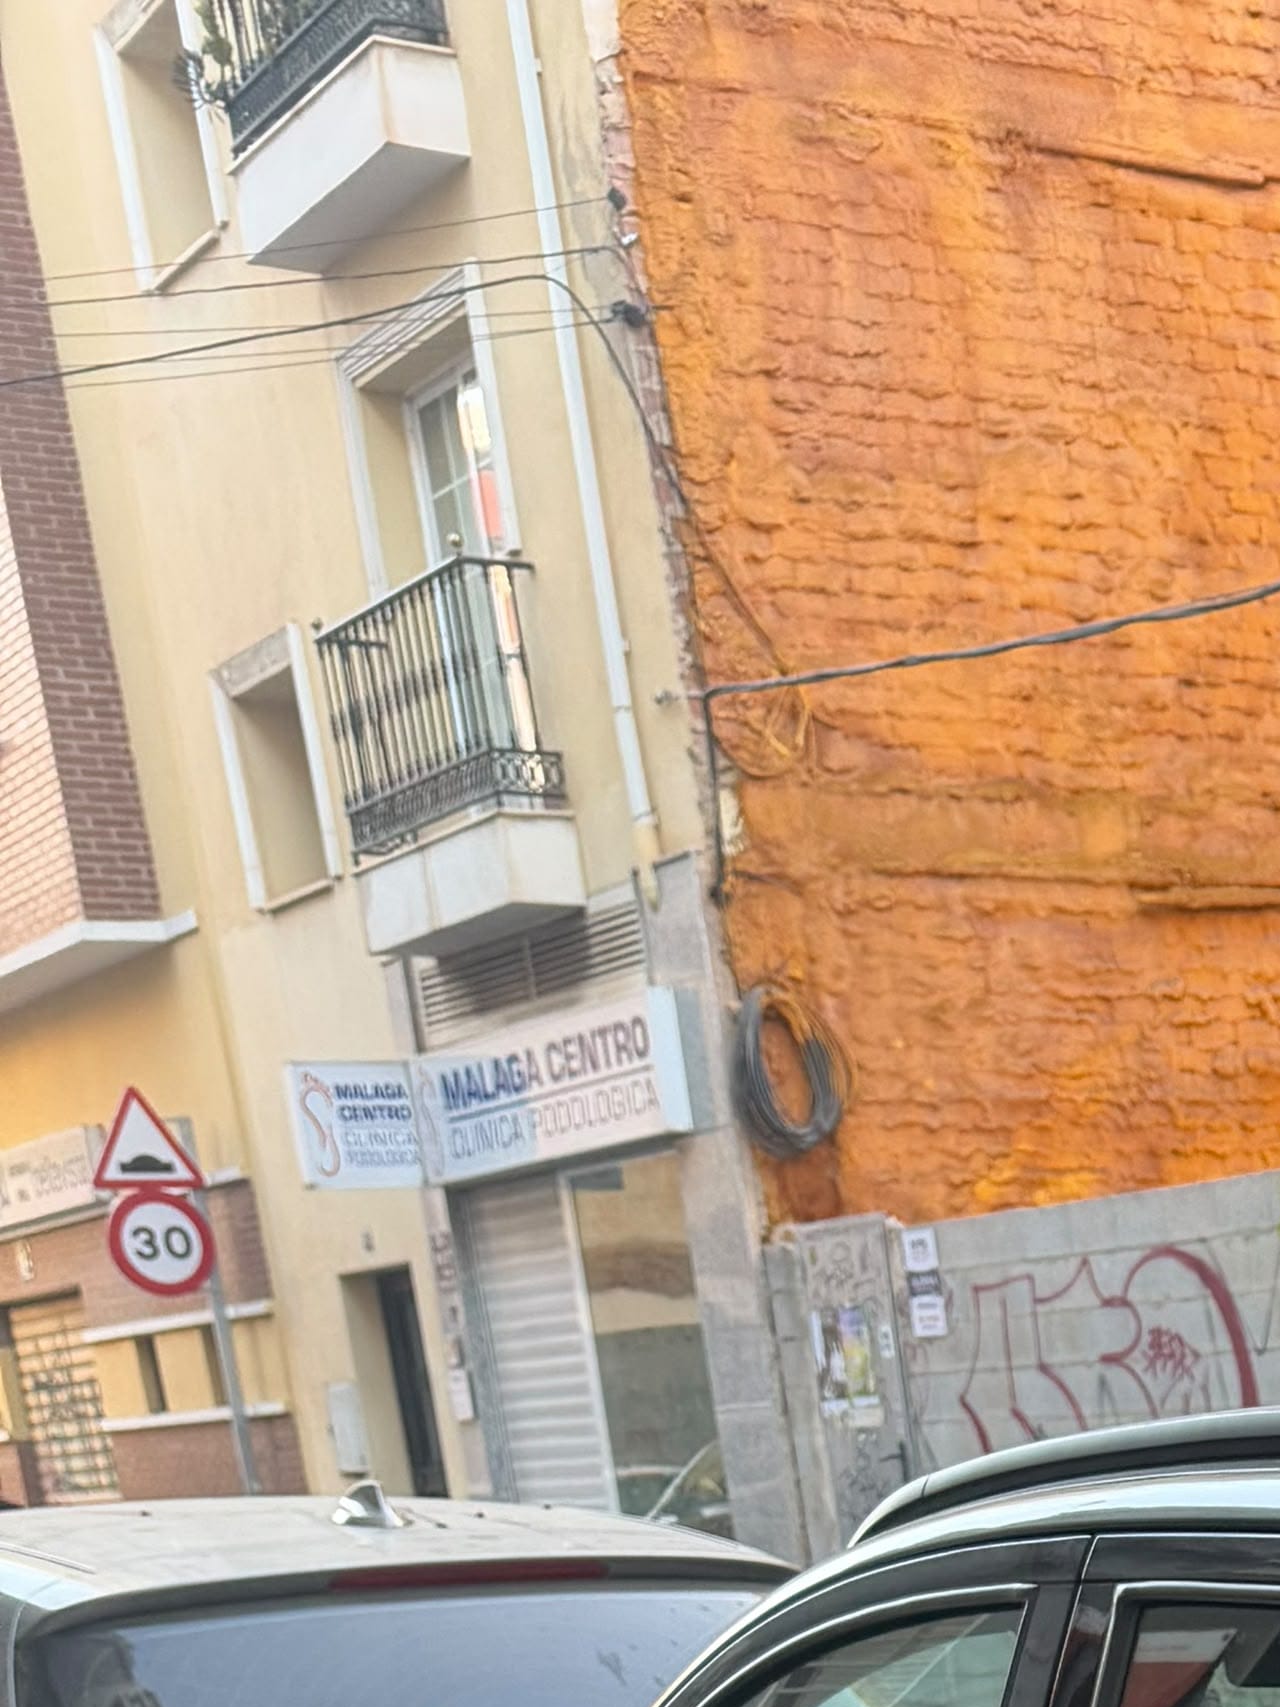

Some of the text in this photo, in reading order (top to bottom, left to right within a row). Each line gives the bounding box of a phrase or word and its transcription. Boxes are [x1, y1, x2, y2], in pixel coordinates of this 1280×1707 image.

[441, 1016, 651, 1112] MALAGA CENTRO
[334, 1083, 409, 1100] MALAGA
[340, 1104, 412, 1121] CENTRO
[451, 1116, 527, 1159] CLINICA
[132, 1226, 192, 1261] 30
